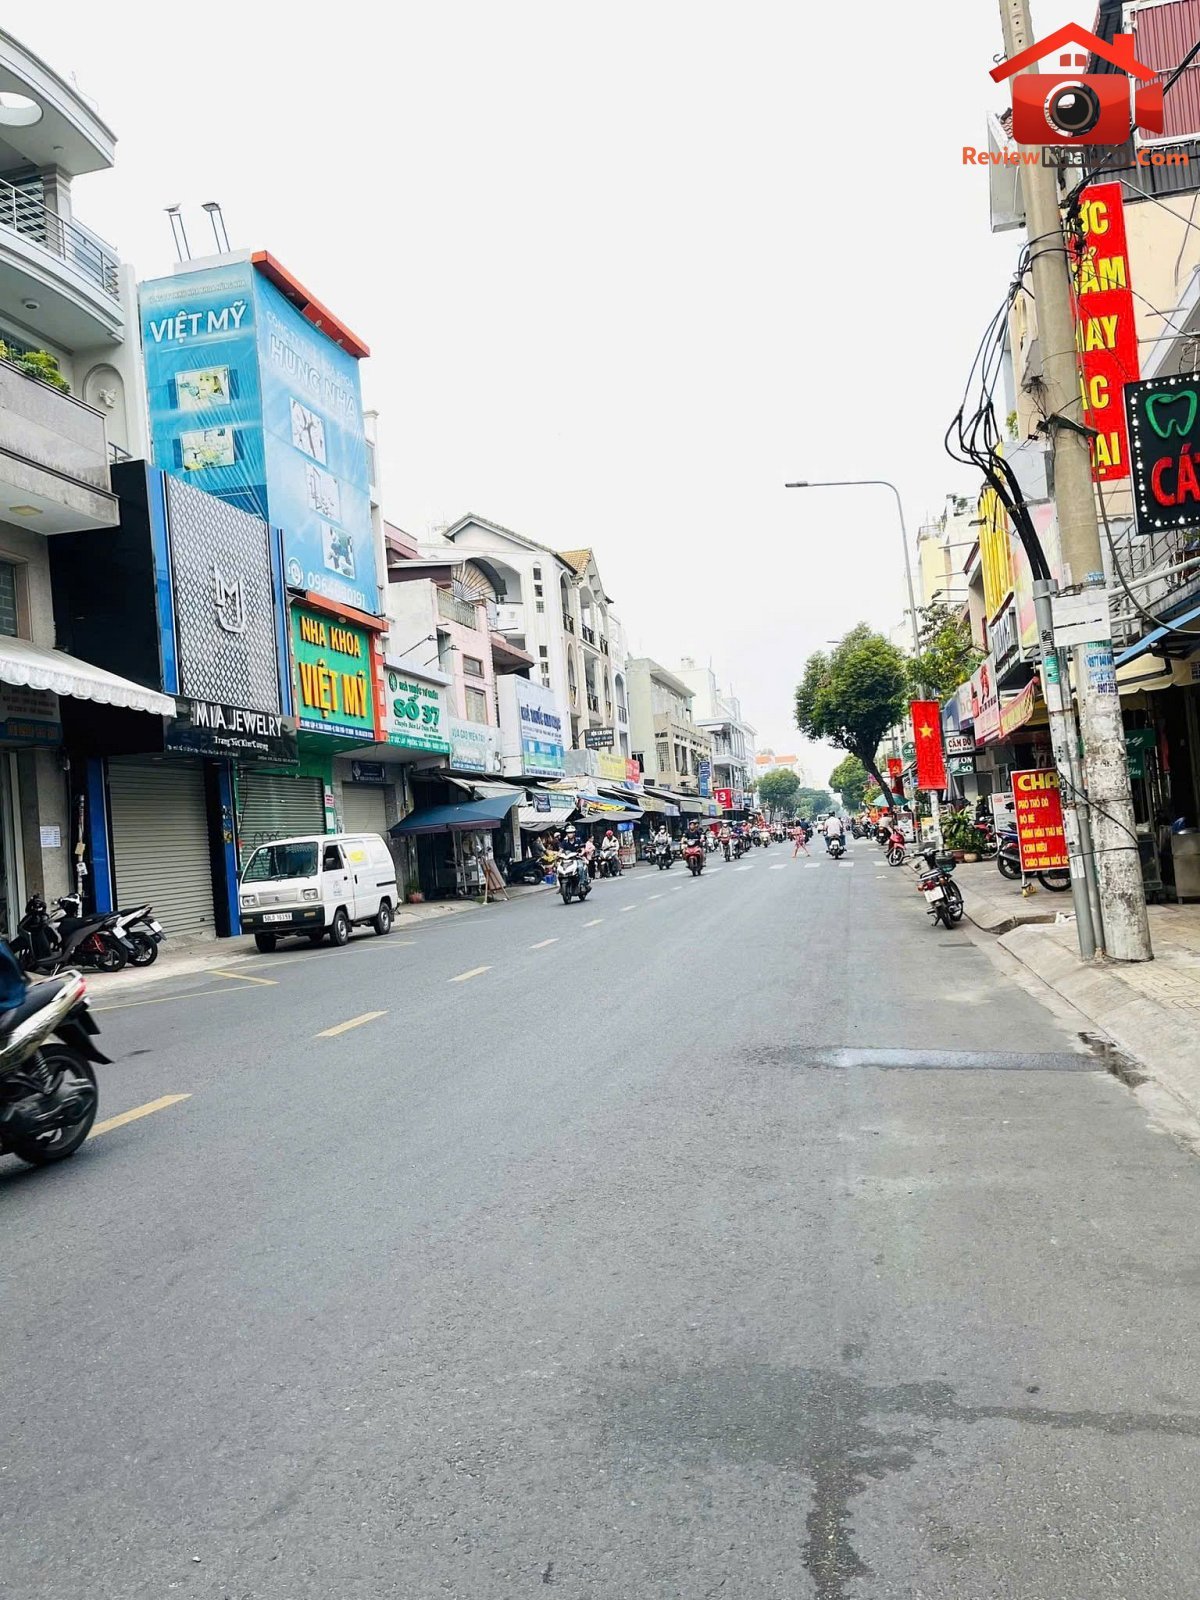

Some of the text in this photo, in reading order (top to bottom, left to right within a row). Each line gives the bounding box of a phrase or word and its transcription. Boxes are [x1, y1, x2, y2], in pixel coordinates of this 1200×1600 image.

[150, 299, 247, 344] VIỆT MỸ
[1151, 443, 1200, 507] CÁ
[301, 616, 362, 658] NHA KHOA
[298, 658, 368, 719] VIỆT MỸ
[393, 694, 440, 726] SỐ 37
[194, 701, 226, 730] MIA
[227, 708, 283, 738] JEWELRY
